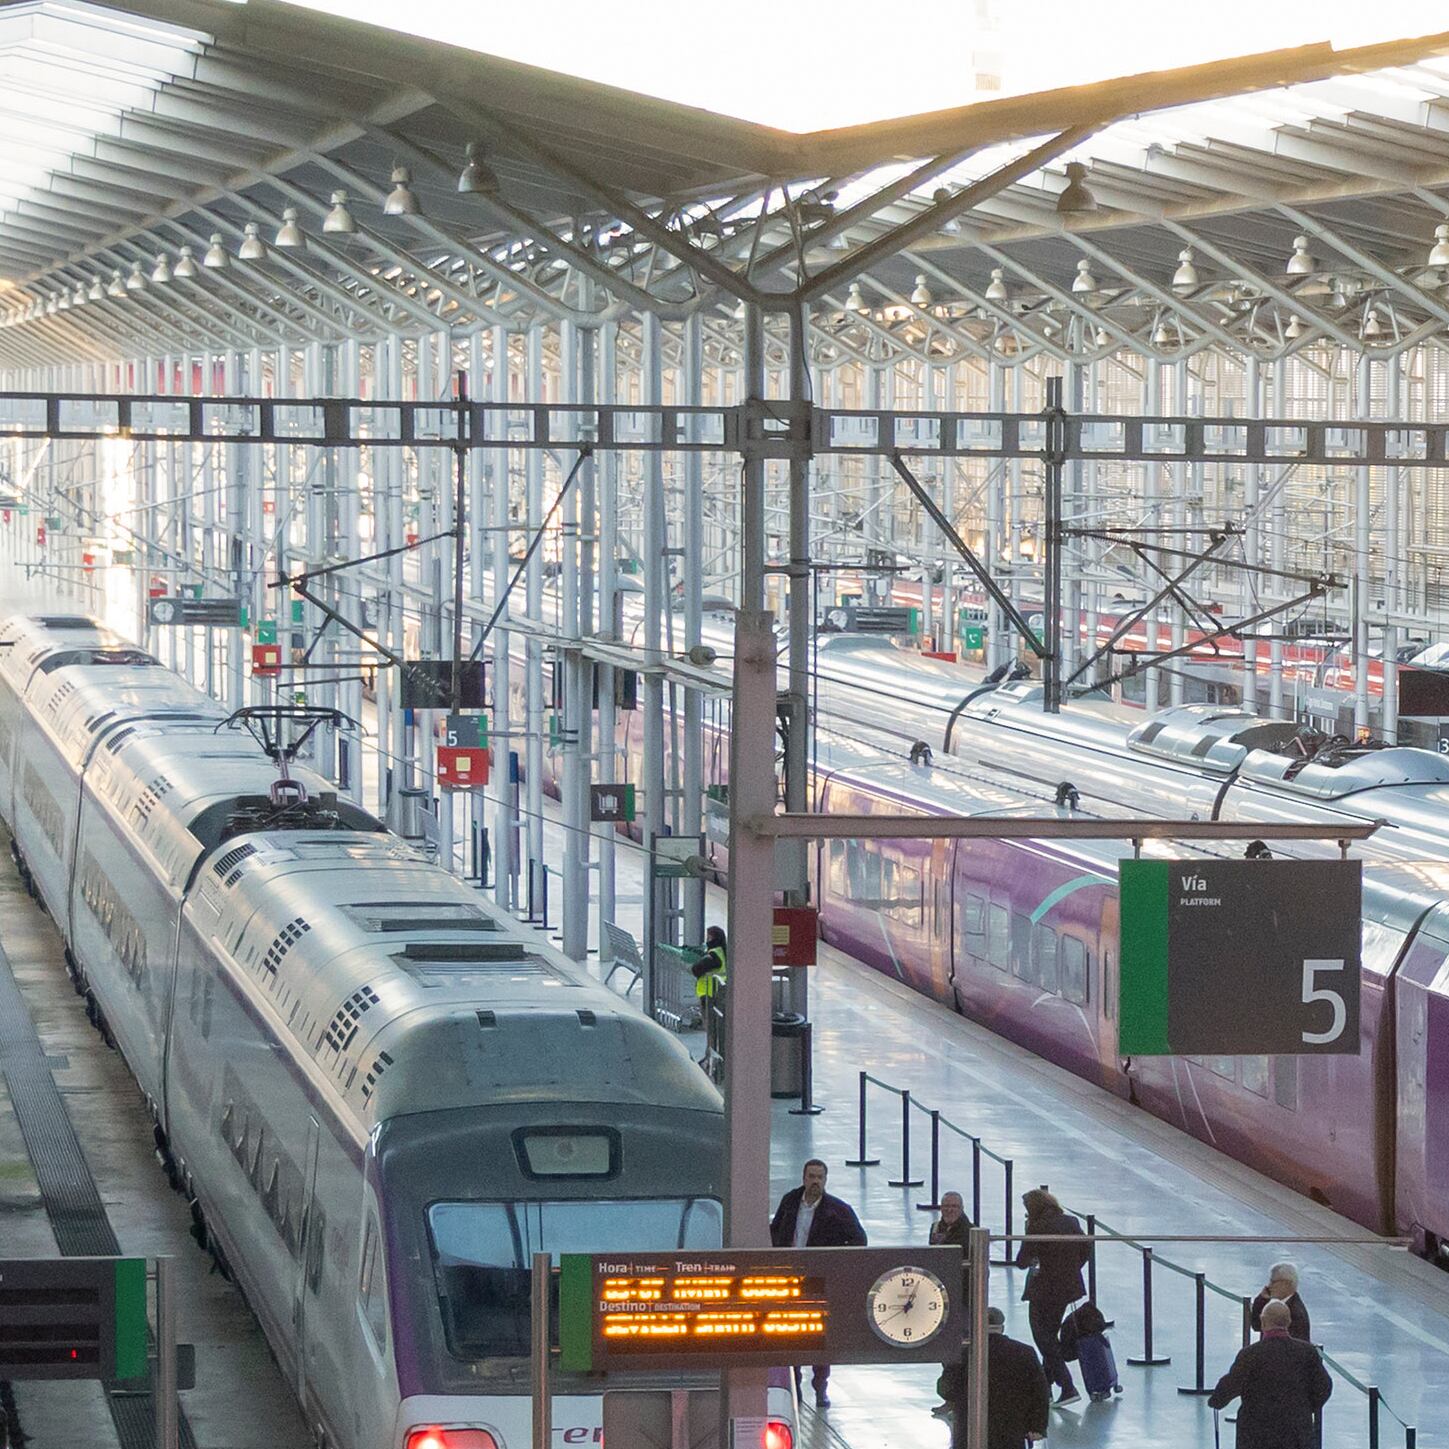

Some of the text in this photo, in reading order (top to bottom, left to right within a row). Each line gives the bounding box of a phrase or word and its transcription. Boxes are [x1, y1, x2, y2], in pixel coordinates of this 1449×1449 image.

[448, 730, 458, 747] 5
[1440, 738, 1449, 753] 3
[1181, 875, 1207, 891] Vía
[1180, 898, 1221, 906] PLATFORM
[1302, 958, 1347, 1044] 5
[599, 1262, 656, 1273] Hora TIME
[675, 1261, 702, 1273] Tren
[902, 1278, 914, 1287] 12
[600, 1300, 700, 1312] Destino DESTINATION
[878, 1303, 886, 1312] 9
[928, 1302, 937, 1311] 3
[903, 1328, 912, 1336] 6
